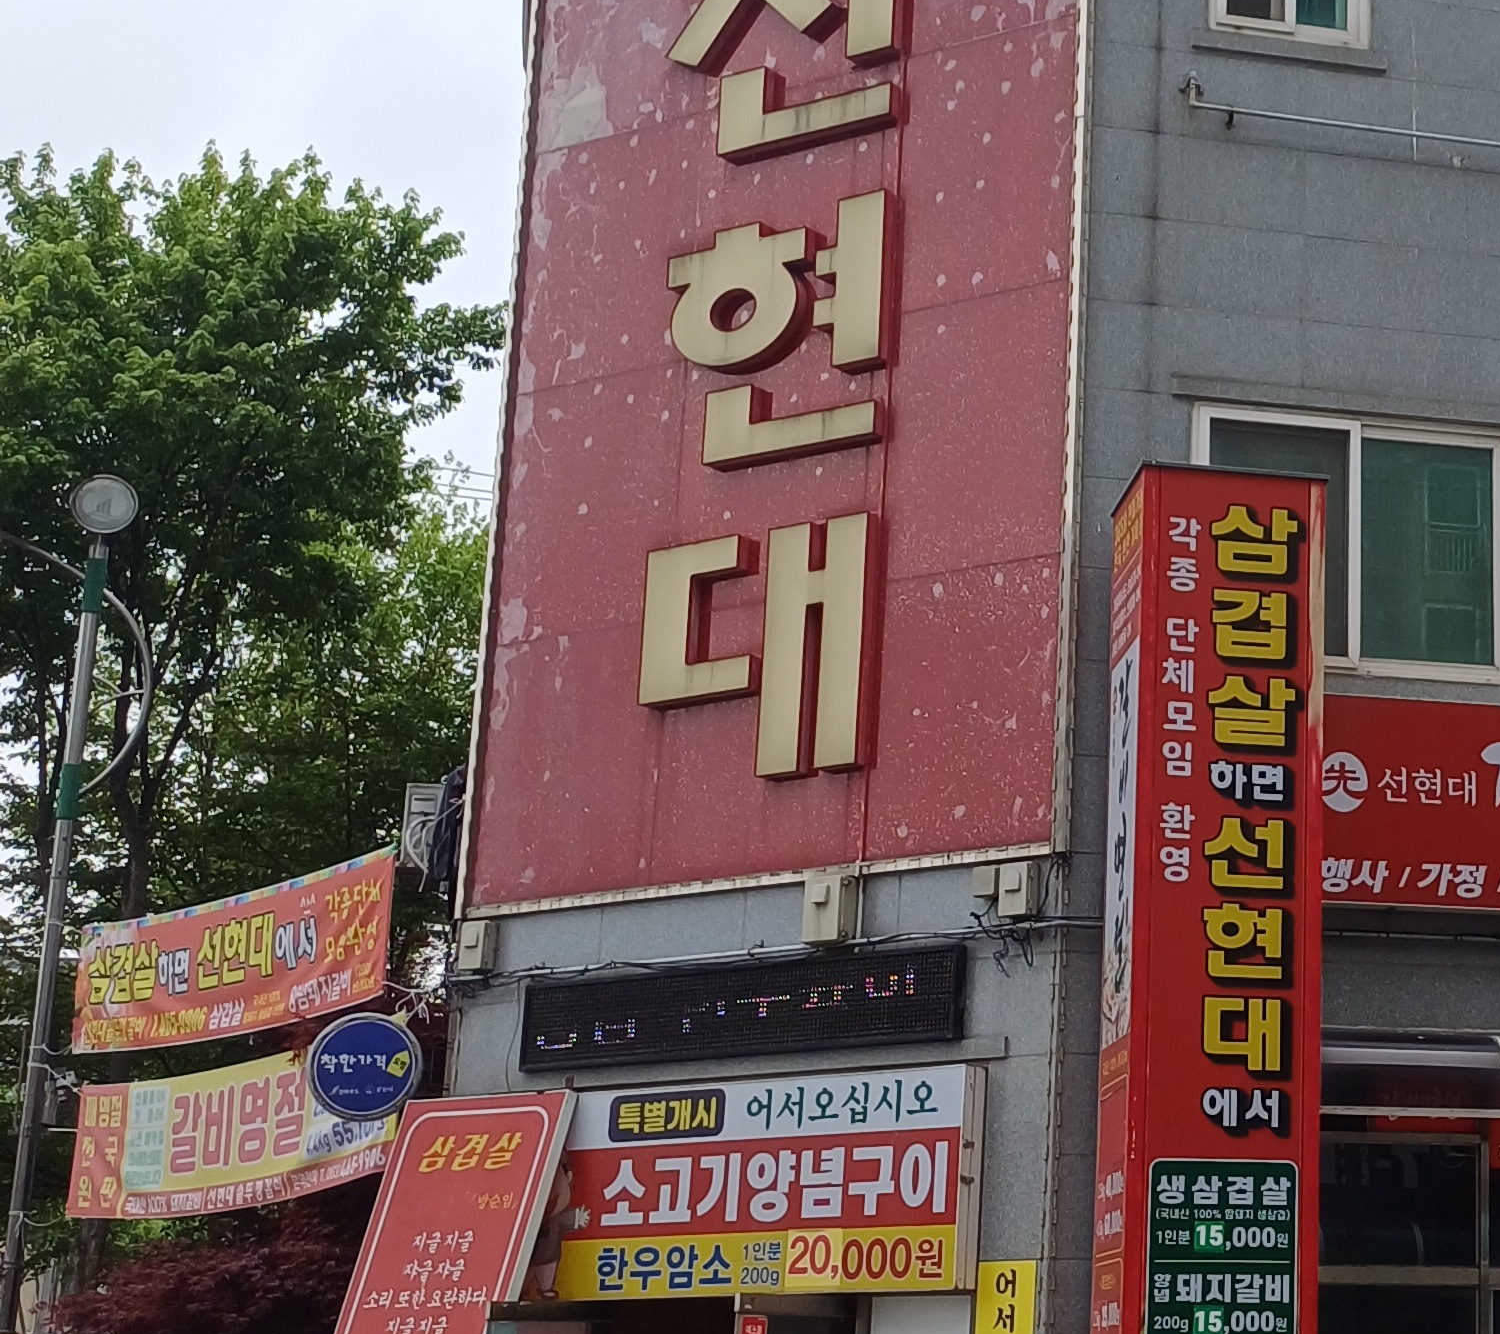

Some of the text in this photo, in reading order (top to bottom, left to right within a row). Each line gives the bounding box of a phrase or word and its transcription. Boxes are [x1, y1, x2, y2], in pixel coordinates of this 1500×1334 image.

[1166, 515, 1200, 592] 각종
[1207, 504, 1299, 748] 삼겹살
[1210, 760, 1285, 802] 하면
[1377, 766, 1477, 807] 선현대
[1159, 802, 1195, 884] 환영
[1321, 856, 1389, 894] 행사
[1417, 864, 1488, 898] 가정
[88, 911, 318, 1005] 삼겹살 하면 선현대 에서
[1202, 816, 1284, 1073] 선현대
[320, 1053, 387, 1074] 착한가격
[169, 1065, 307, 1176] 갈비명절
[616, 1080, 939, 1132] 특별개시 어서오십시오
[1202, 1088, 1280, 1128] 에서
[418, 1132, 522, 1173] 삼겹살
[600, 1140, 950, 1228] 소고기양념구이
[1156, 1175, 1291, 1205] 생삼겹살
[1194, 1208, 1221, 1219] 100%
[742, 1240, 782, 1263] 1인분
[1156, 1224, 1289, 1252] 1인분 15,000원
[596, 1235, 944, 1292] 한우암소 20,000원
[740, 1264, 780, 1287] 200g
[363, 1286, 487, 1309] 소리 또한 요란하다
[1153, 1273, 1290, 1303] 양념 돼지갈비
[1153, 1310, 1288, 1334] 200g 15,000원
